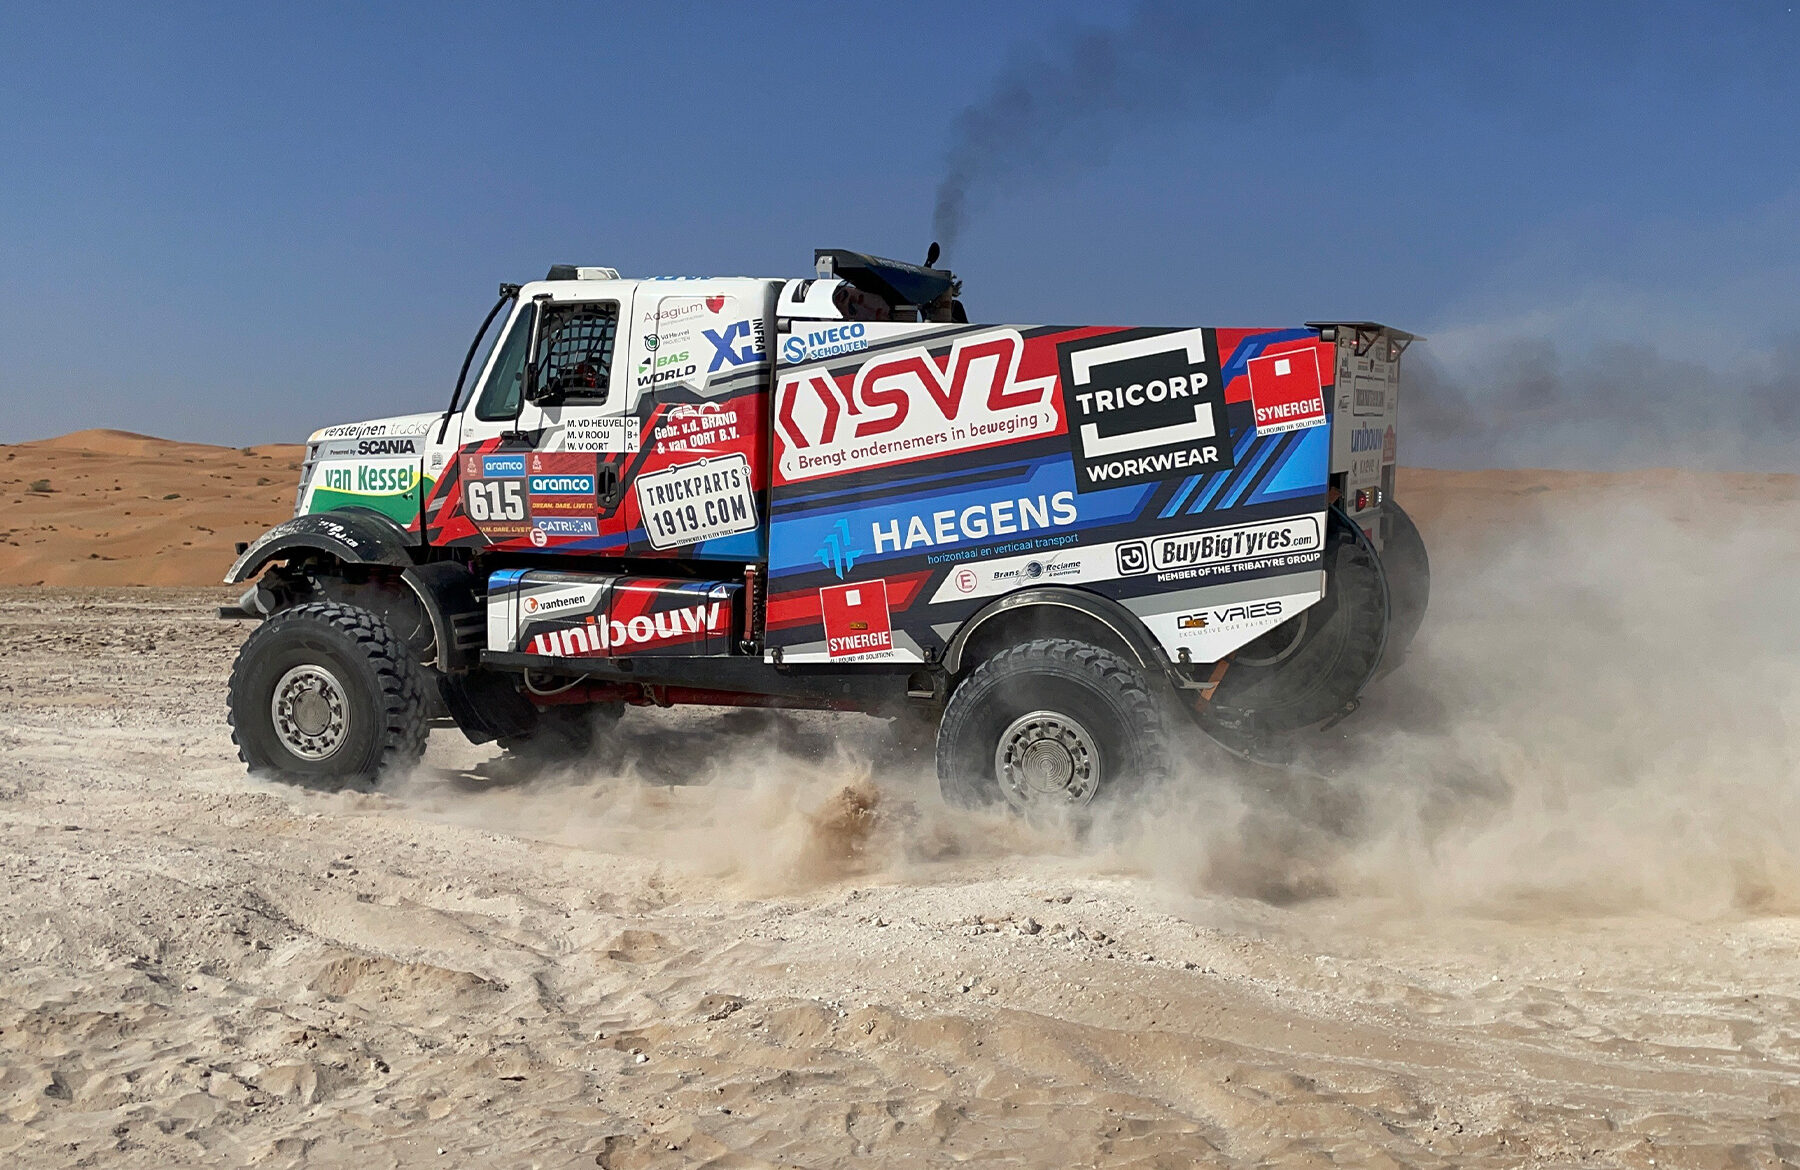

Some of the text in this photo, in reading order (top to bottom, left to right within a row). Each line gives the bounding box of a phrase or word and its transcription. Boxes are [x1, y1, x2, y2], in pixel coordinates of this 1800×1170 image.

[643, 303, 703, 322] Adagium
[701, 320, 767, 373] XL
[752, 318, 766, 351] INFRA
[808, 323, 865, 347] IVECO
[656, 351, 689, 367] BAS
[810, 339, 868, 358] SCHOUTEN
[637, 365, 697, 386] WORLD
[855, 338, 1045, 438] SVZ
[1075, 373, 1208, 415] TRICORP
[1257, 397, 1321, 421] SYNERGIE
[324, 421, 428, 440] versteijnen trucks
[567, 418, 624, 428] M. VD HEUVEL
[567, 431, 610, 439] M. V ROOIJ
[627, 431, 638, 439] B+
[654, 410, 737, 441] Gebr. v.d. BRAND
[357, 439, 415, 455] SCANIA
[567, 443, 578, 451] W.
[656, 426, 740, 454] & van OORT B.V.
[798, 413, 1038, 470] Brengt ondernemers in beweging
[1351, 421, 1383, 453] unibouw
[325, 464, 413, 490] van Kessel
[485, 460, 523, 471] aramco
[1086, 446, 1219, 482] WORKWEAR
[532, 478, 590, 491] aramco
[646, 468, 741, 506] TRUCKPARTS
[468, 481, 524, 521] 615
[652, 494, 747, 537] 1919.COM
[871, 490, 1078, 554] HAEGENS
[927, 533, 1079, 564] horizontaal en verticaal transport
[1161, 528, 1312, 564] BuyBigTyres.com
[993, 560, 1081, 579] Brans Reclame
[1157, 552, 1321, 582] MEMBER OF THE TRIBATYRE GROUP
[1177, 601, 1282, 629] DE VRIES
[1179, 628, 1221, 638] EXCLUSIVE
[1245, 617, 1283, 628] PAINTING
[534, 602, 720, 656] unibouw
[829, 631, 890, 652] SYNERGIE
